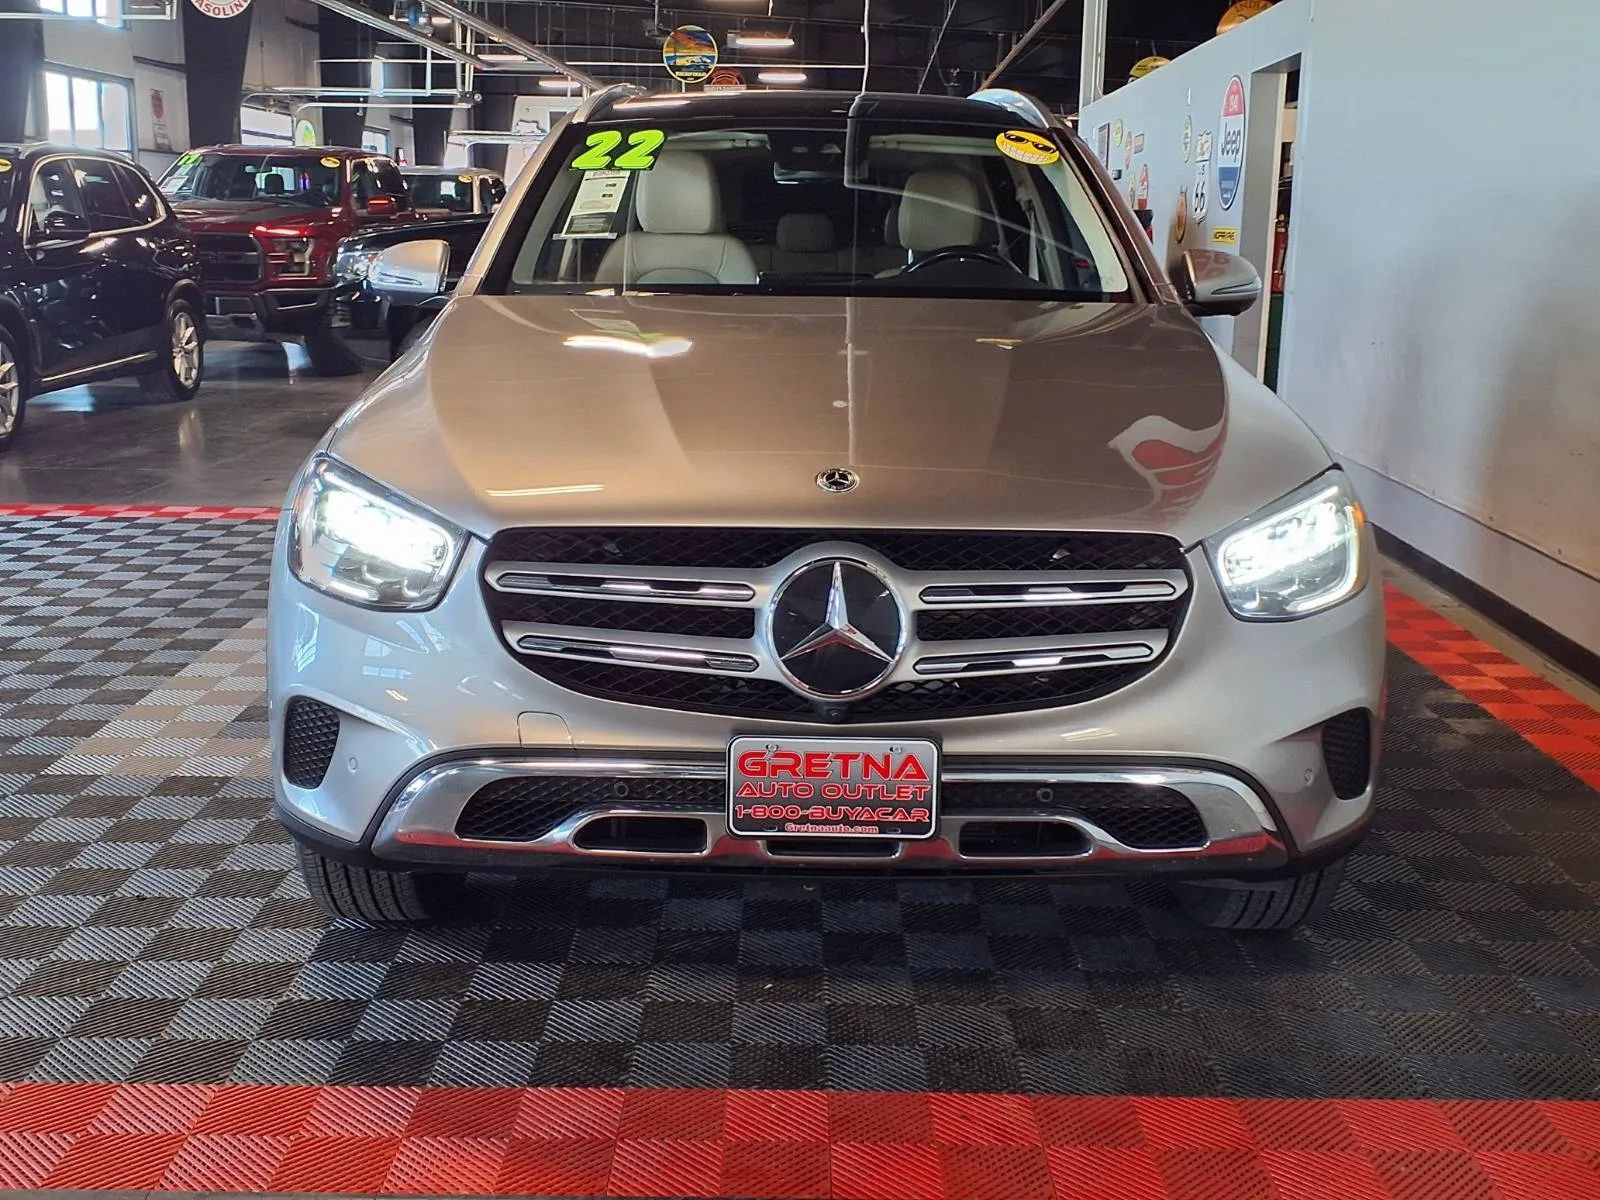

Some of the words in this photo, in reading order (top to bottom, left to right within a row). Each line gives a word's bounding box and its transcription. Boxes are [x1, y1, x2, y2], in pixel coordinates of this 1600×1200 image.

[571, 129, 665, 169] 22
[1221, 122, 1242, 162] Jeep
[1194, 181, 1206, 212] 66
[736, 750, 929, 781] GRETNA
[736, 781, 814, 799] AUTO
[820, 782, 932, 801] OUTLET
[735, 805, 930, 822] 1-800-BUYACAR
[784, 822, 879, 834] Gretnaauto.com
